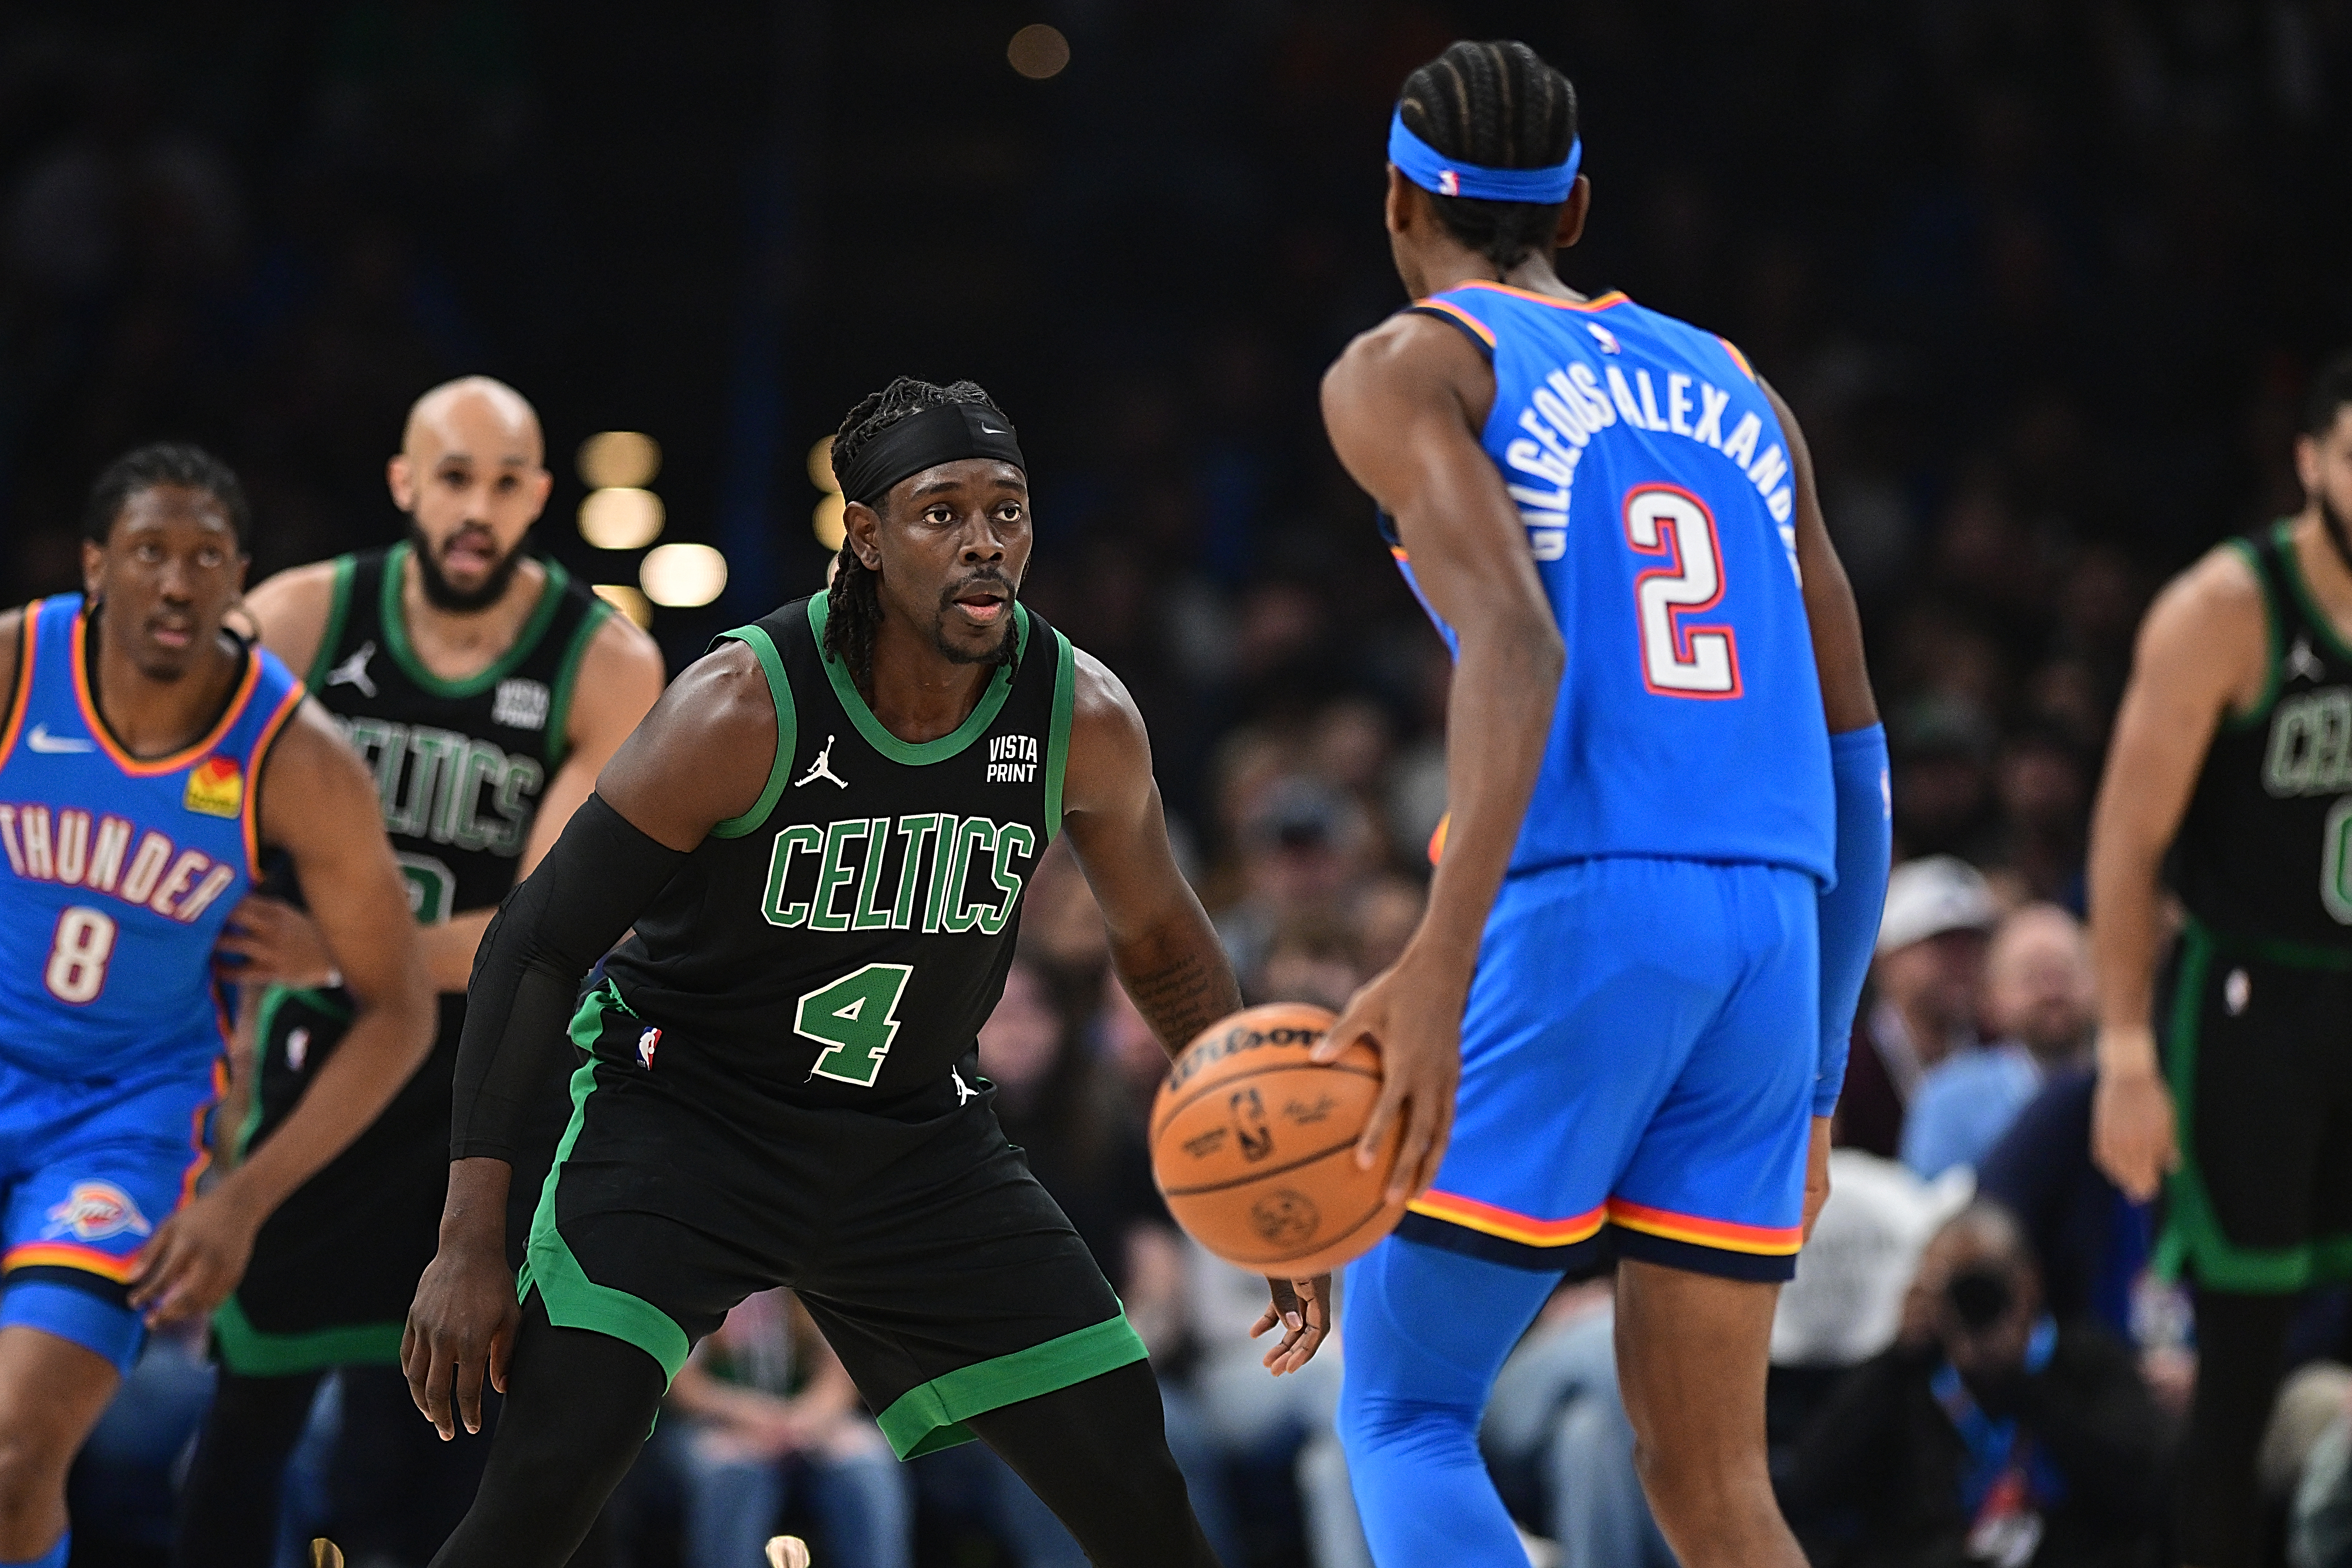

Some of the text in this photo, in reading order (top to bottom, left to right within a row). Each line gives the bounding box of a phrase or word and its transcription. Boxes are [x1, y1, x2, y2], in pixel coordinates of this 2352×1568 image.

[1622, 482, 1743, 699] 2
[987, 764, 1037, 783] PRINT
[990, 735, 1037, 763] VISTA
[761, 813, 1035, 935] CELTICS
[43, 905, 118, 1006] 8
[637, 1059, 646, 1068] NBA
[794, 963, 914, 1087] 4
